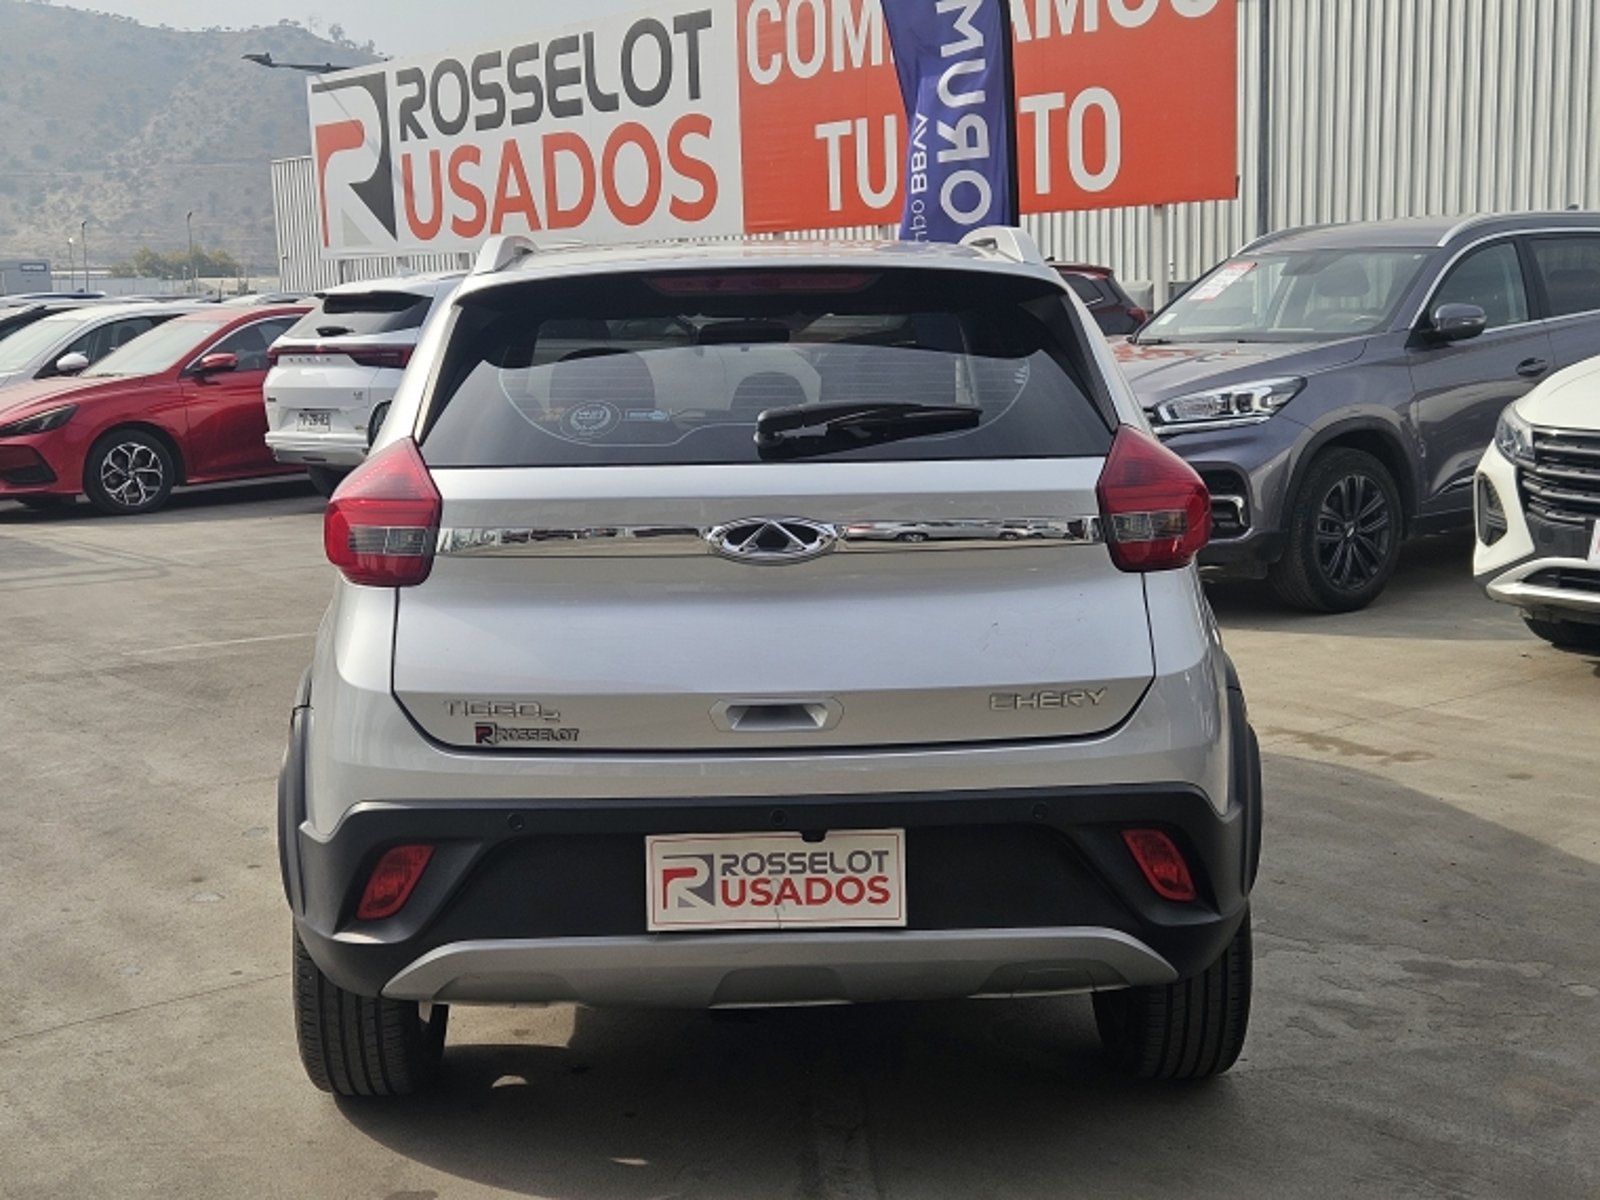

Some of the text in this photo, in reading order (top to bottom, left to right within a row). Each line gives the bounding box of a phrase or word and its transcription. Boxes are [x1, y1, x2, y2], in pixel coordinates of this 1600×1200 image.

[397, 9, 712, 141] ROSSELOT
[401, 113, 719, 241] USADOS
[815, 115, 898, 211] TU
[990, 687, 1107, 711] CHERY
[498, 727, 580, 743] ROSSELOT
[720, 850, 889, 876] ROSSELOT
[721, 875, 891, 908] USADOS
